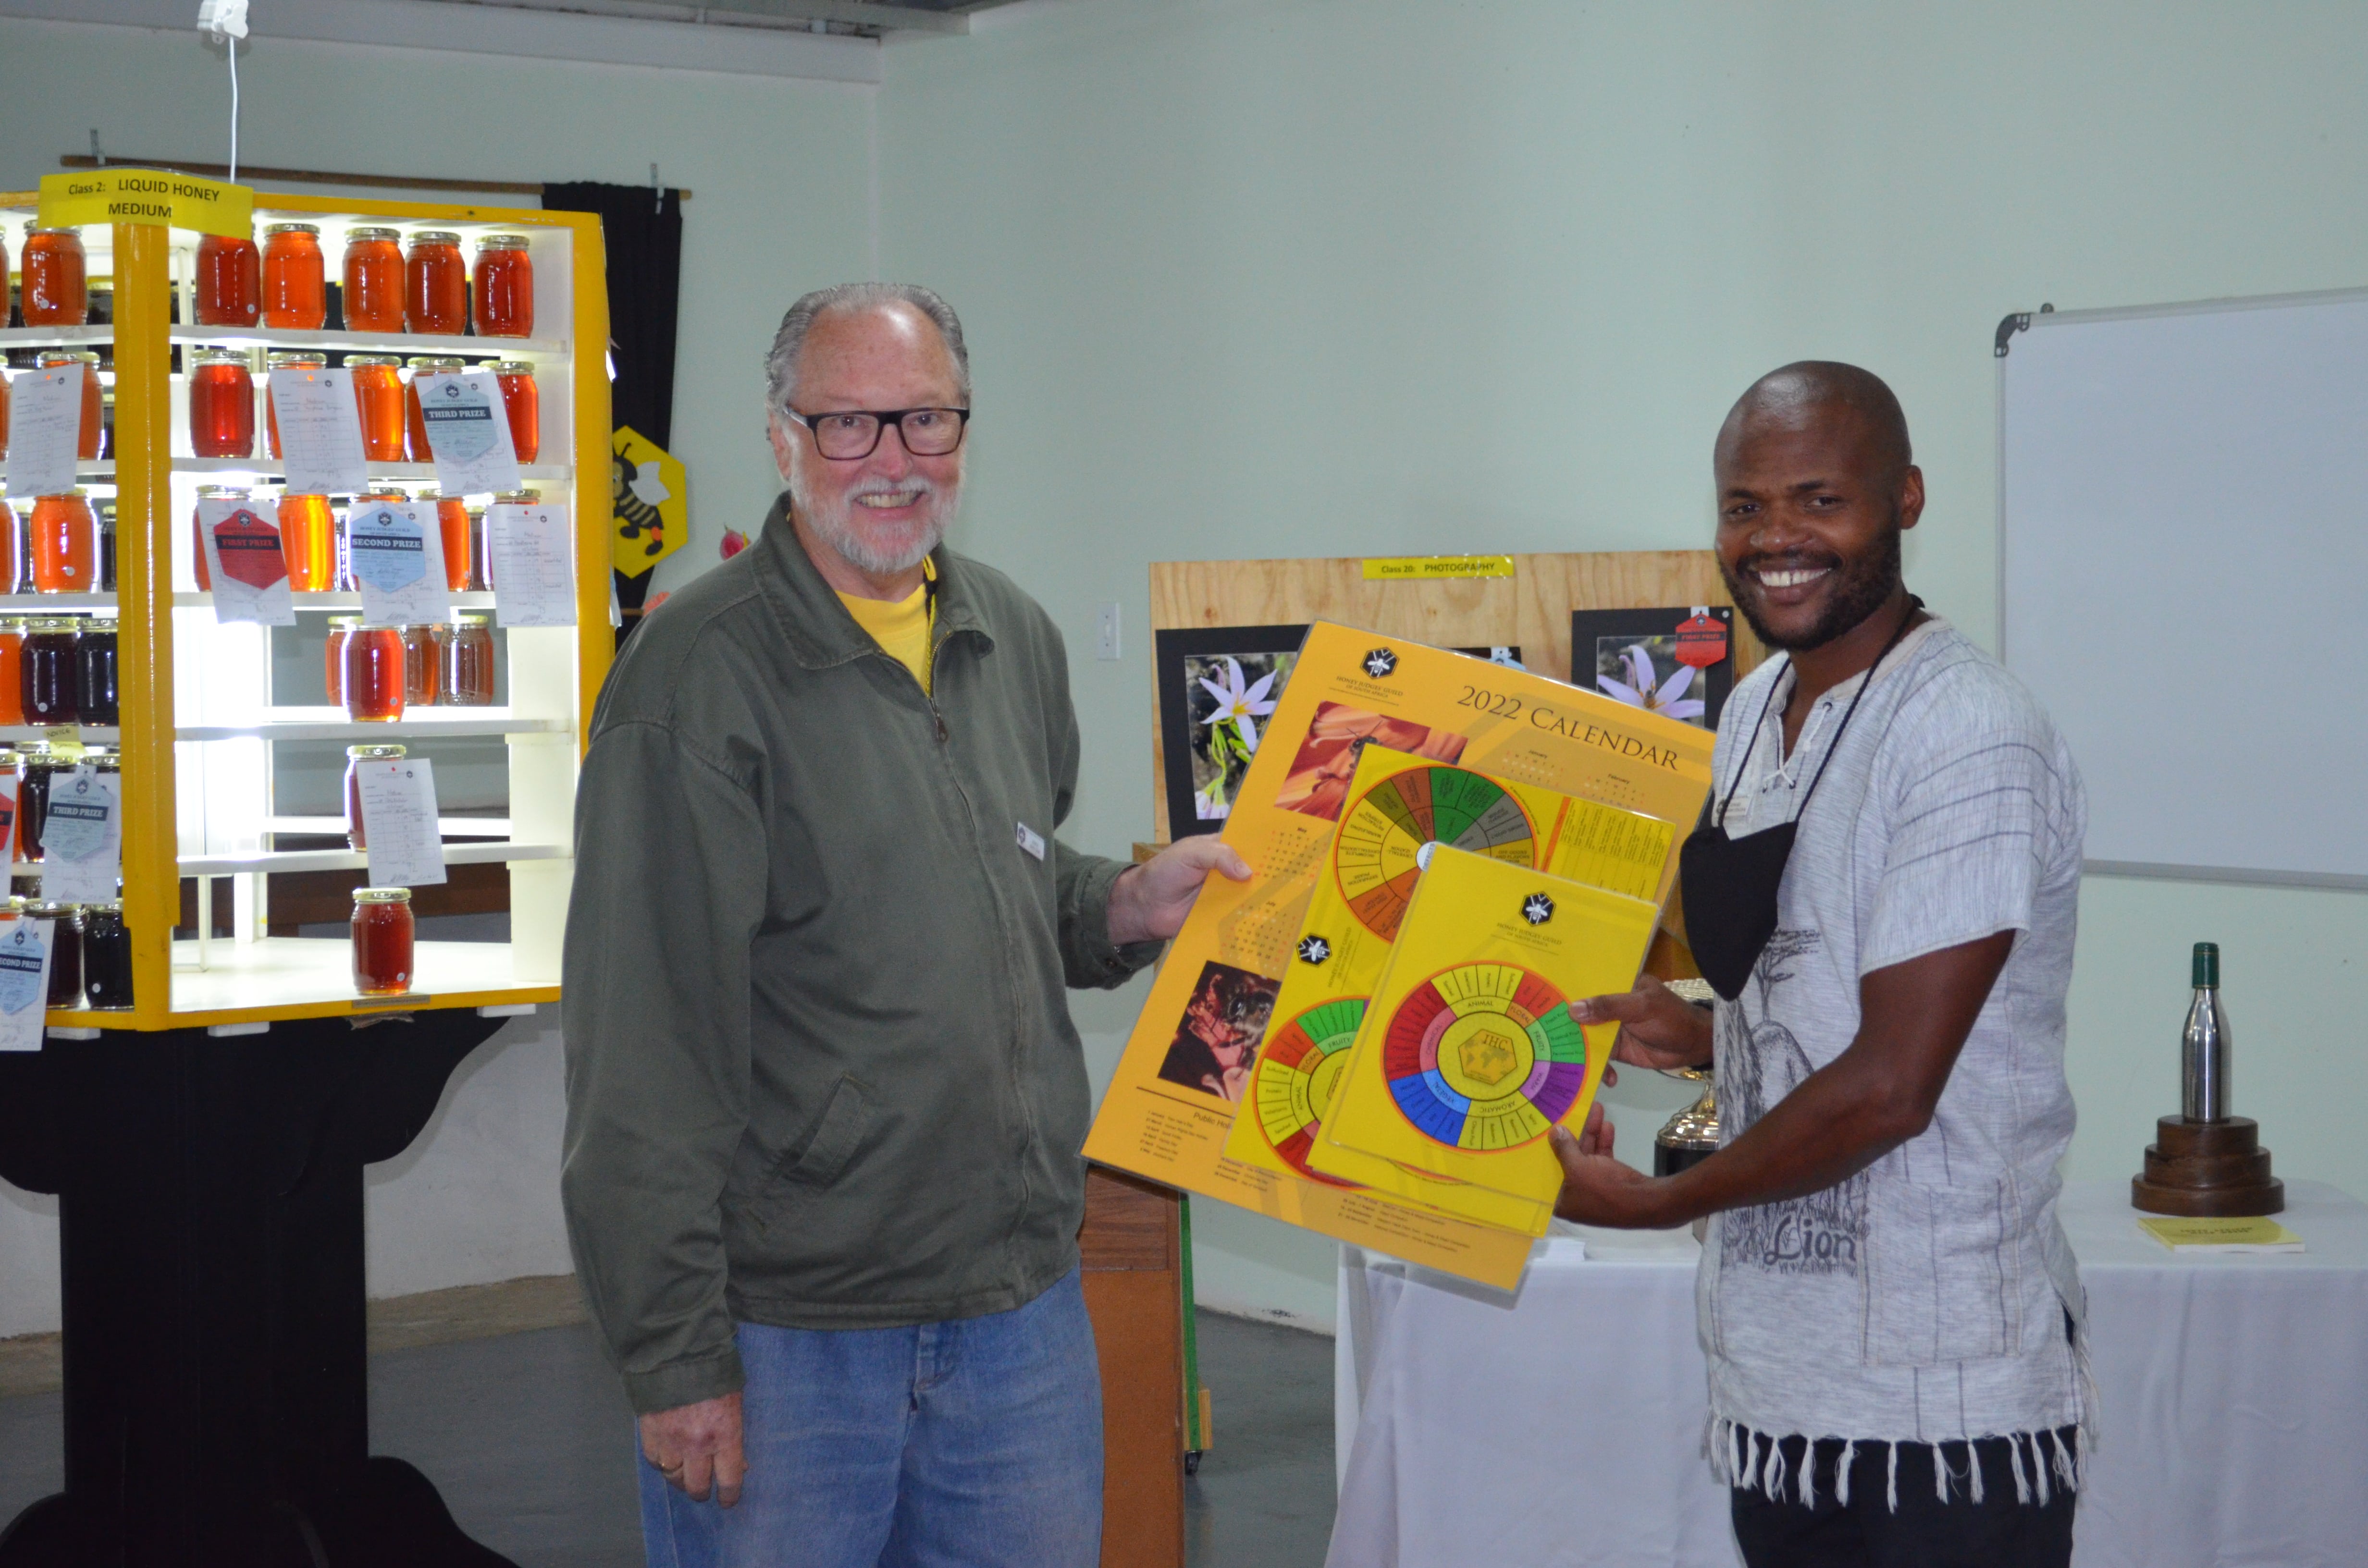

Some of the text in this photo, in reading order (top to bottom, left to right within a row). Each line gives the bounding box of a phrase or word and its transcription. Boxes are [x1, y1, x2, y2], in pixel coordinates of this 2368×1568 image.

[69, 179, 219, 201] Class 2: LIQUID HONEY
[109, 203, 172, 218] MEDIUM
[352, 539, 421, 548] SECOND PRIZE
[1381, 563, 1495, 573] Class 20: PHOTOGRAPHY
[1336, 676, 1358, 685] HONEY
[1383, 687, 1404, 696] GUILD
[1457, 685, 1522, 719] 2022
[1530, 707, 1678, 771] CALENDAR
[1608, 773, 1630, 784] February
[53, 806, 103, 817] THIRD PRIZE
[1422, 843, 1435, 870] DEFECTS
[1497, 922, 1517, 931] HONEY
[0, 957, 41, 969] ECOND PRIZE
[1510, 1006, 1530, 1024] FLORAL
[1328, 1037, 1350, 1048] FRUITY
[1426, 1025, 1441, 1055] CHEMICAL
[1482, 1033, 1508, 1051] IHC
[1534, 1031, 1545, 1051] FRUITY
[1303, 1050, 1320, 1070] FLORAL
[1433, 1081, 1454, 1103] VEGETAL
[1480, 1101, 1515, 1113] AROMATIC
[1193, 1112, 1231, 1129] Public Holi
[1764, 1215, 1856, 1266] Lion
